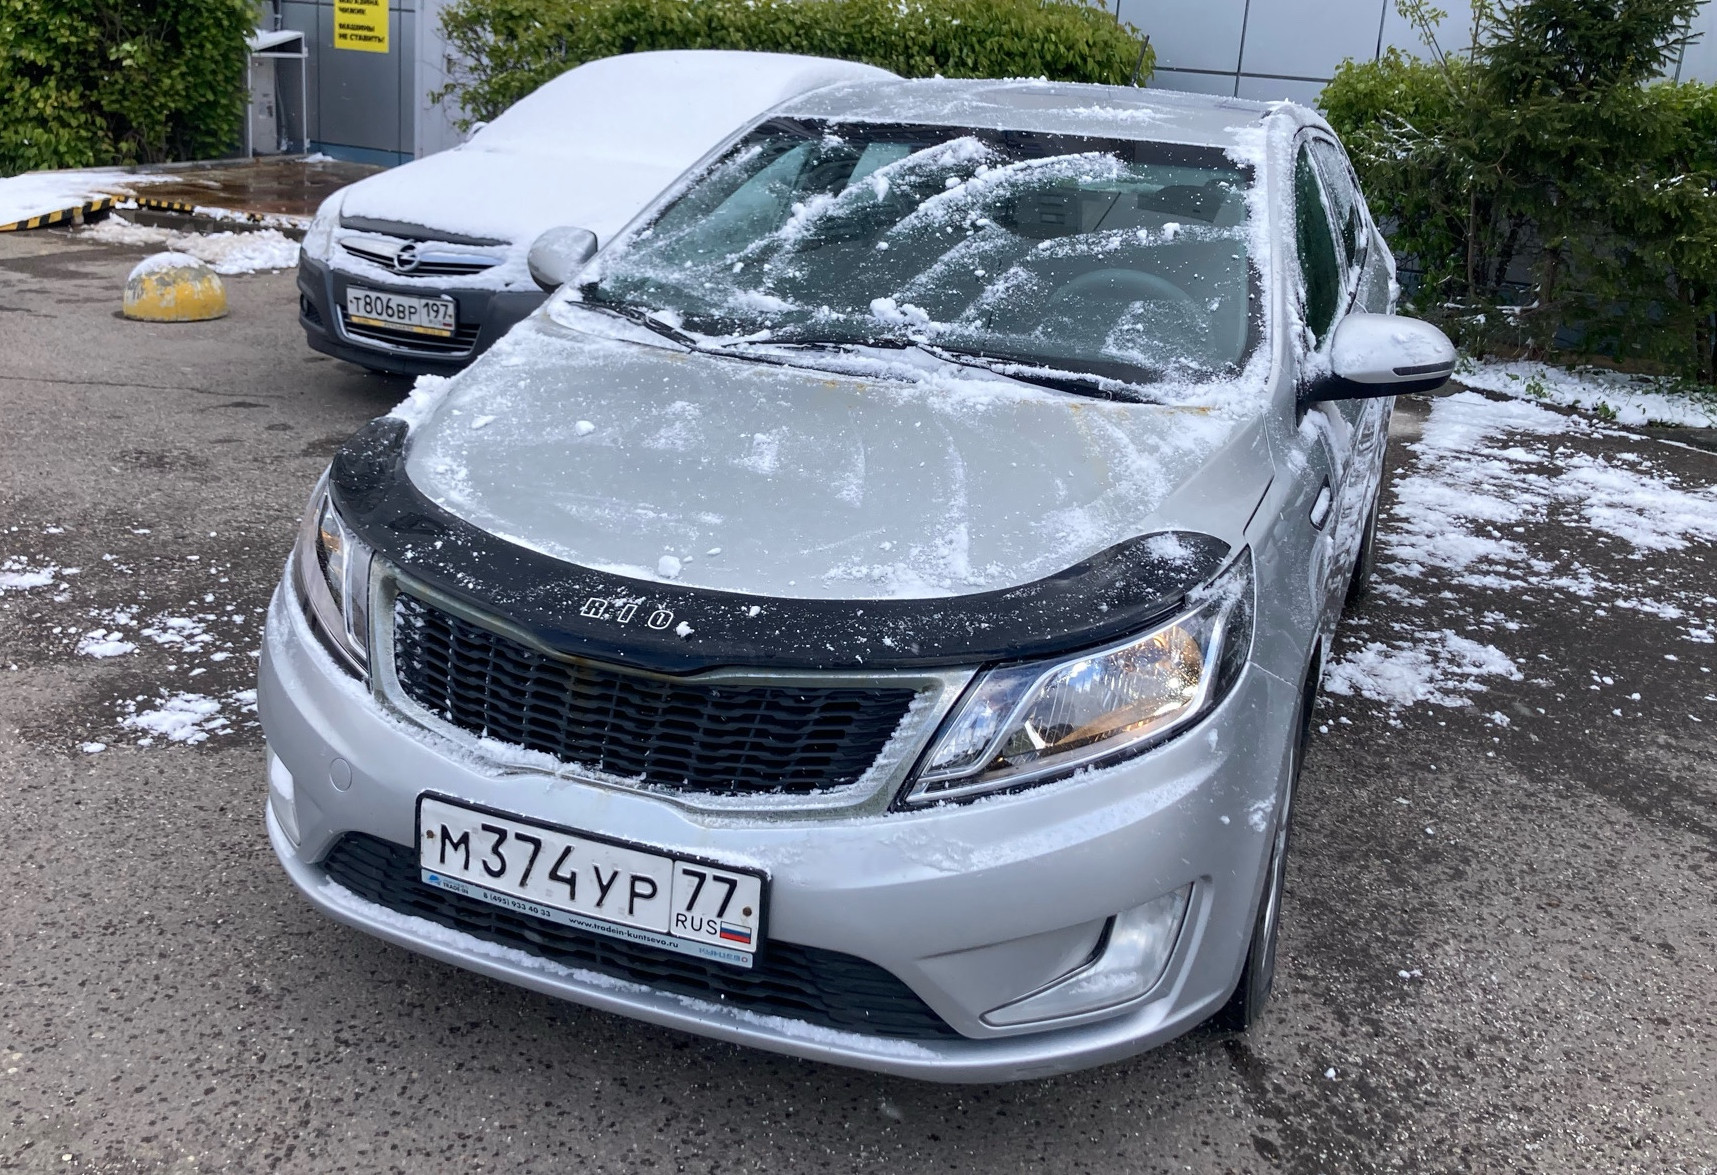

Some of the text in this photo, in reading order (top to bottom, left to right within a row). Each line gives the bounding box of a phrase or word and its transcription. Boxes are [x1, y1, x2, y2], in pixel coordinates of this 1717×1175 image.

[338, 23, 375, 32] МАШИНЫ
[353, 295, 449, 321] Т806ВР 197
[580, 597, 674, 630] RIO
[440, 823, 738, 918] М374УР 77
[483, 891, 551, 917] 8 (495) 933 40 33
[568, 917, 679, 949] www.tradein-kuntsevo.ru
[675, 912, 718, 935] RUS
